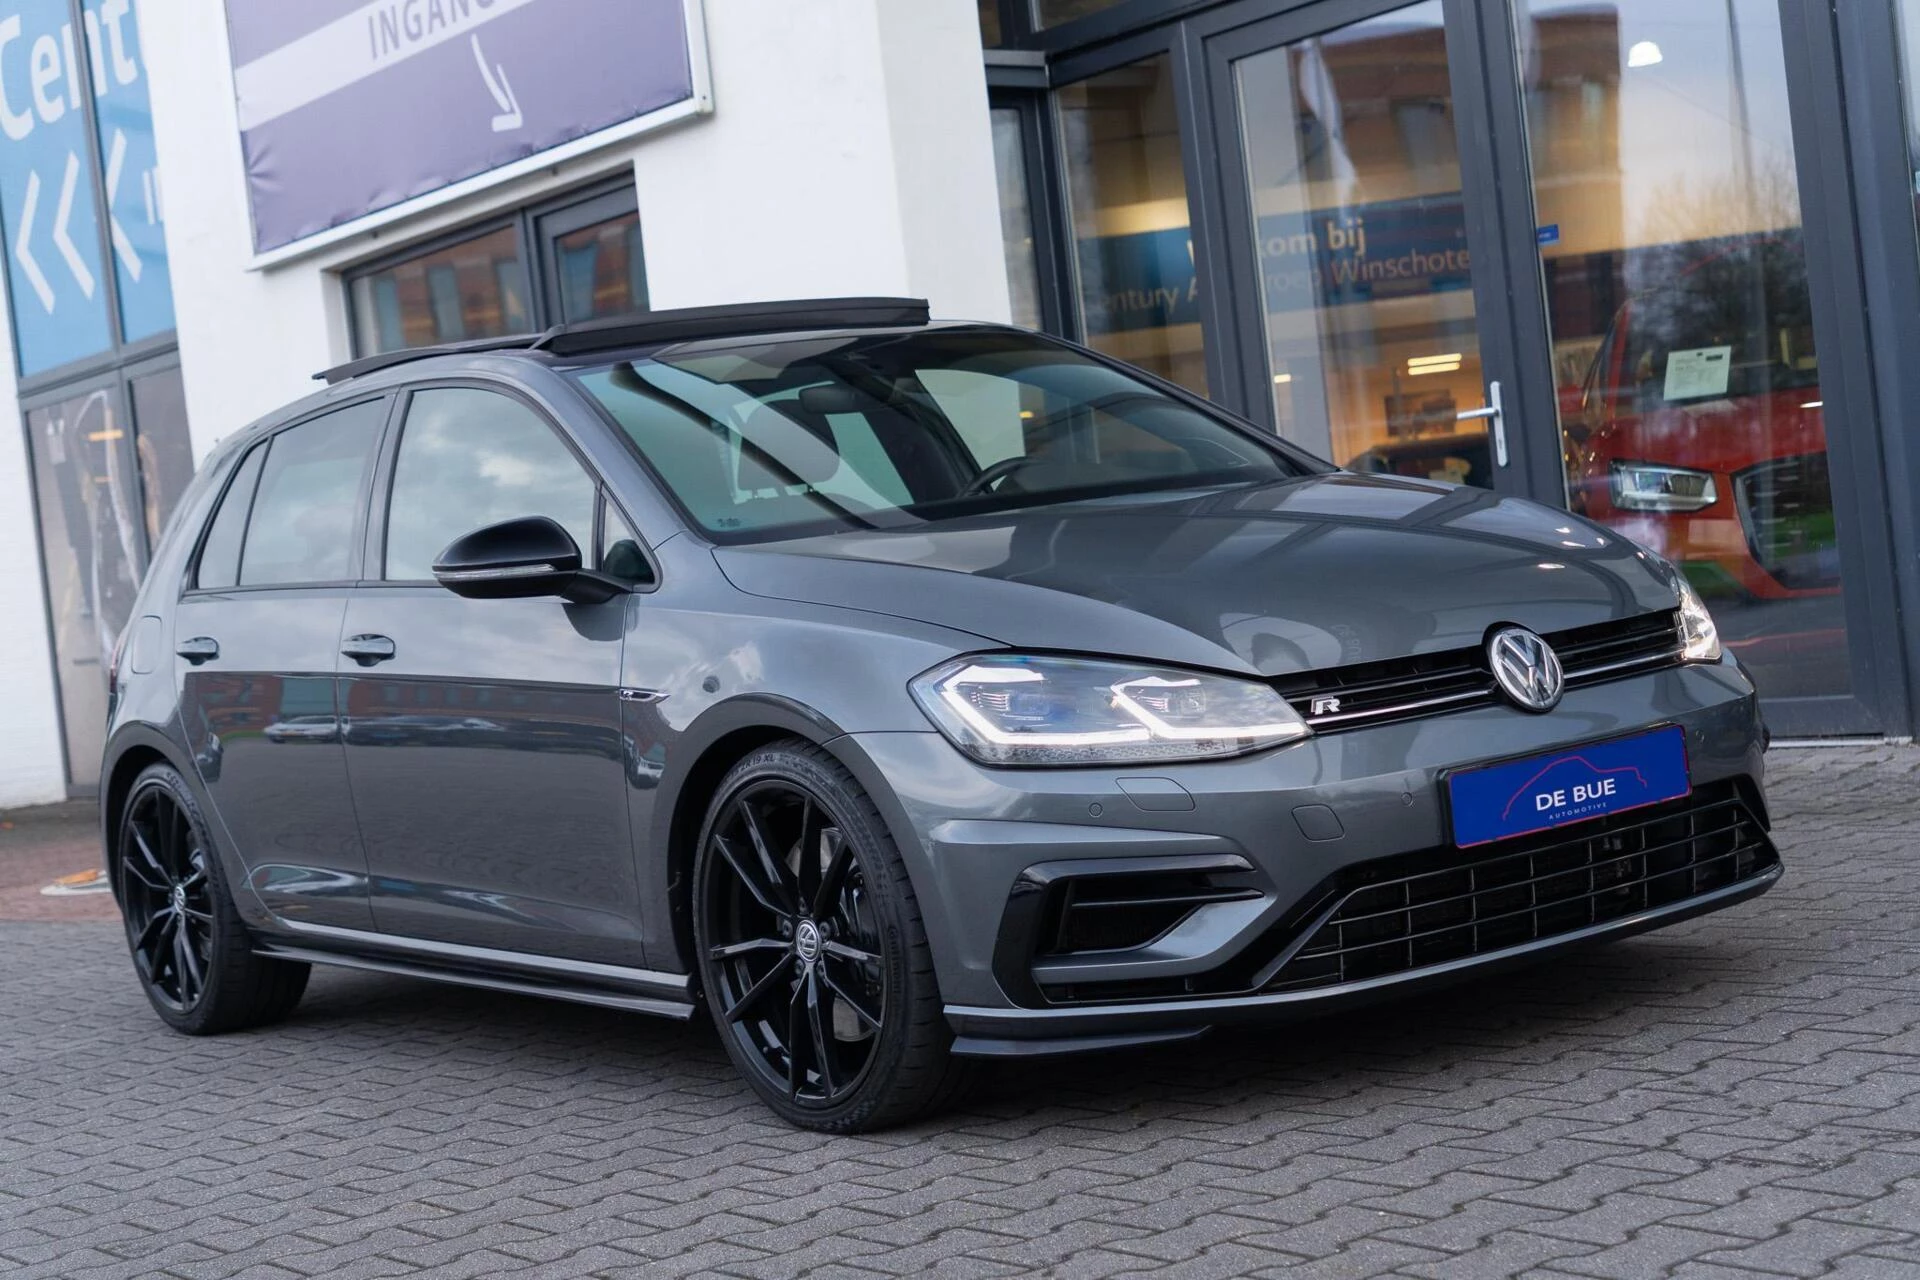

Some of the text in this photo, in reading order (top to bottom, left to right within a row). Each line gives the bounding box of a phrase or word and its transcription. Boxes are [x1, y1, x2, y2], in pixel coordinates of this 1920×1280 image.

[368, 0, 495, 60] INGAN
[0, 0, 139, 141] Cent
[1327, 217, 1366, 257] bij
[1331, 246, 1471, 287] Winschote
[1535, 778, 1616, 811] DE BUE
[1548, 802, 1607, 820] AUTOMOTIVE
